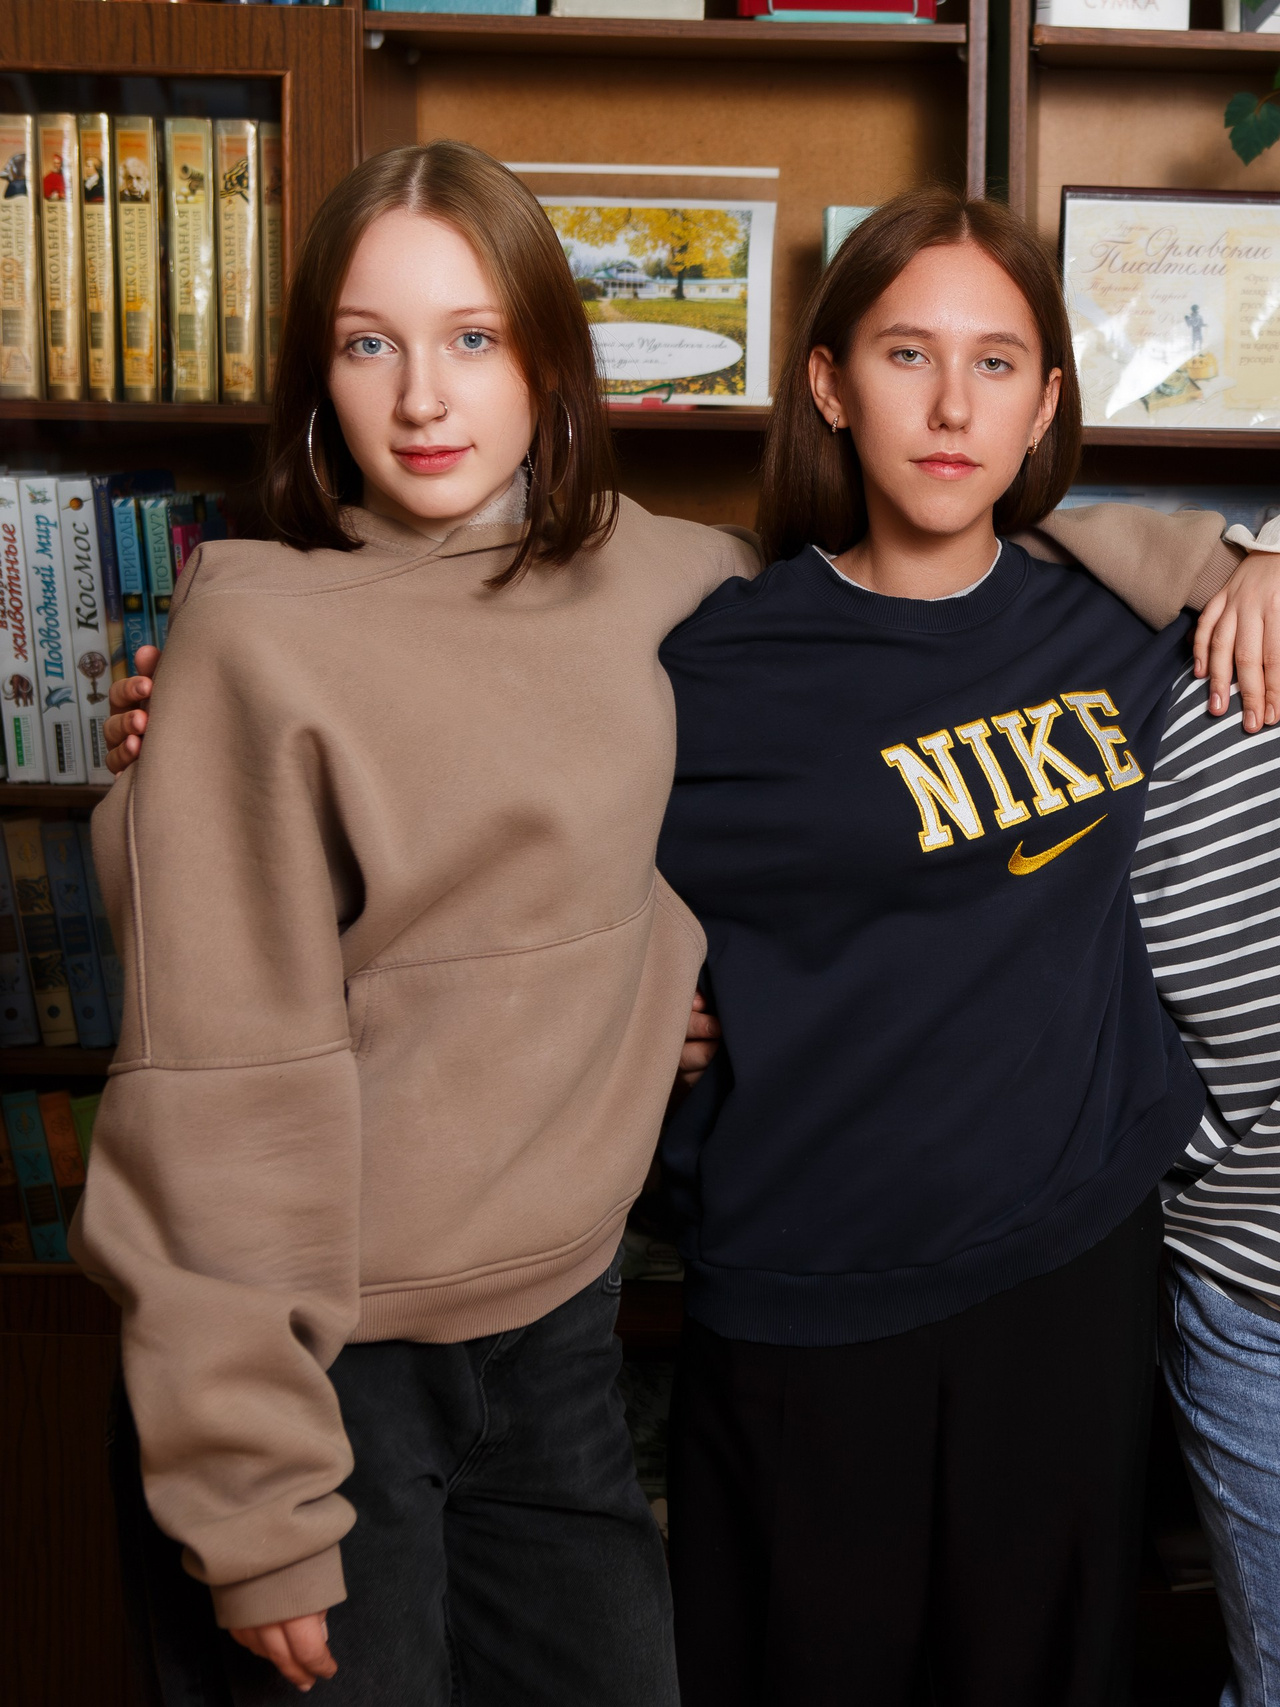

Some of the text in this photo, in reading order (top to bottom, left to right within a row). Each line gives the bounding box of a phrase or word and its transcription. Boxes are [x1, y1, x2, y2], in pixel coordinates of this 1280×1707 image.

[46, 204, 60, 302] ШКОЛЬНАЯ
[124, 207, 136, 303] ШКОЛЬНАЯ
[178, 209, 191, 306] ШКОЛЬНАЯ
[32, 513, 65, 681] Подводный мир
[73, 522, 100, 634] Космос
[121, 511, 140, 591] ПРИРОДЫ
[151, 511, 172, 591] ПОЧЕМУ?
[881, 689, 1145, 852] NIKE
